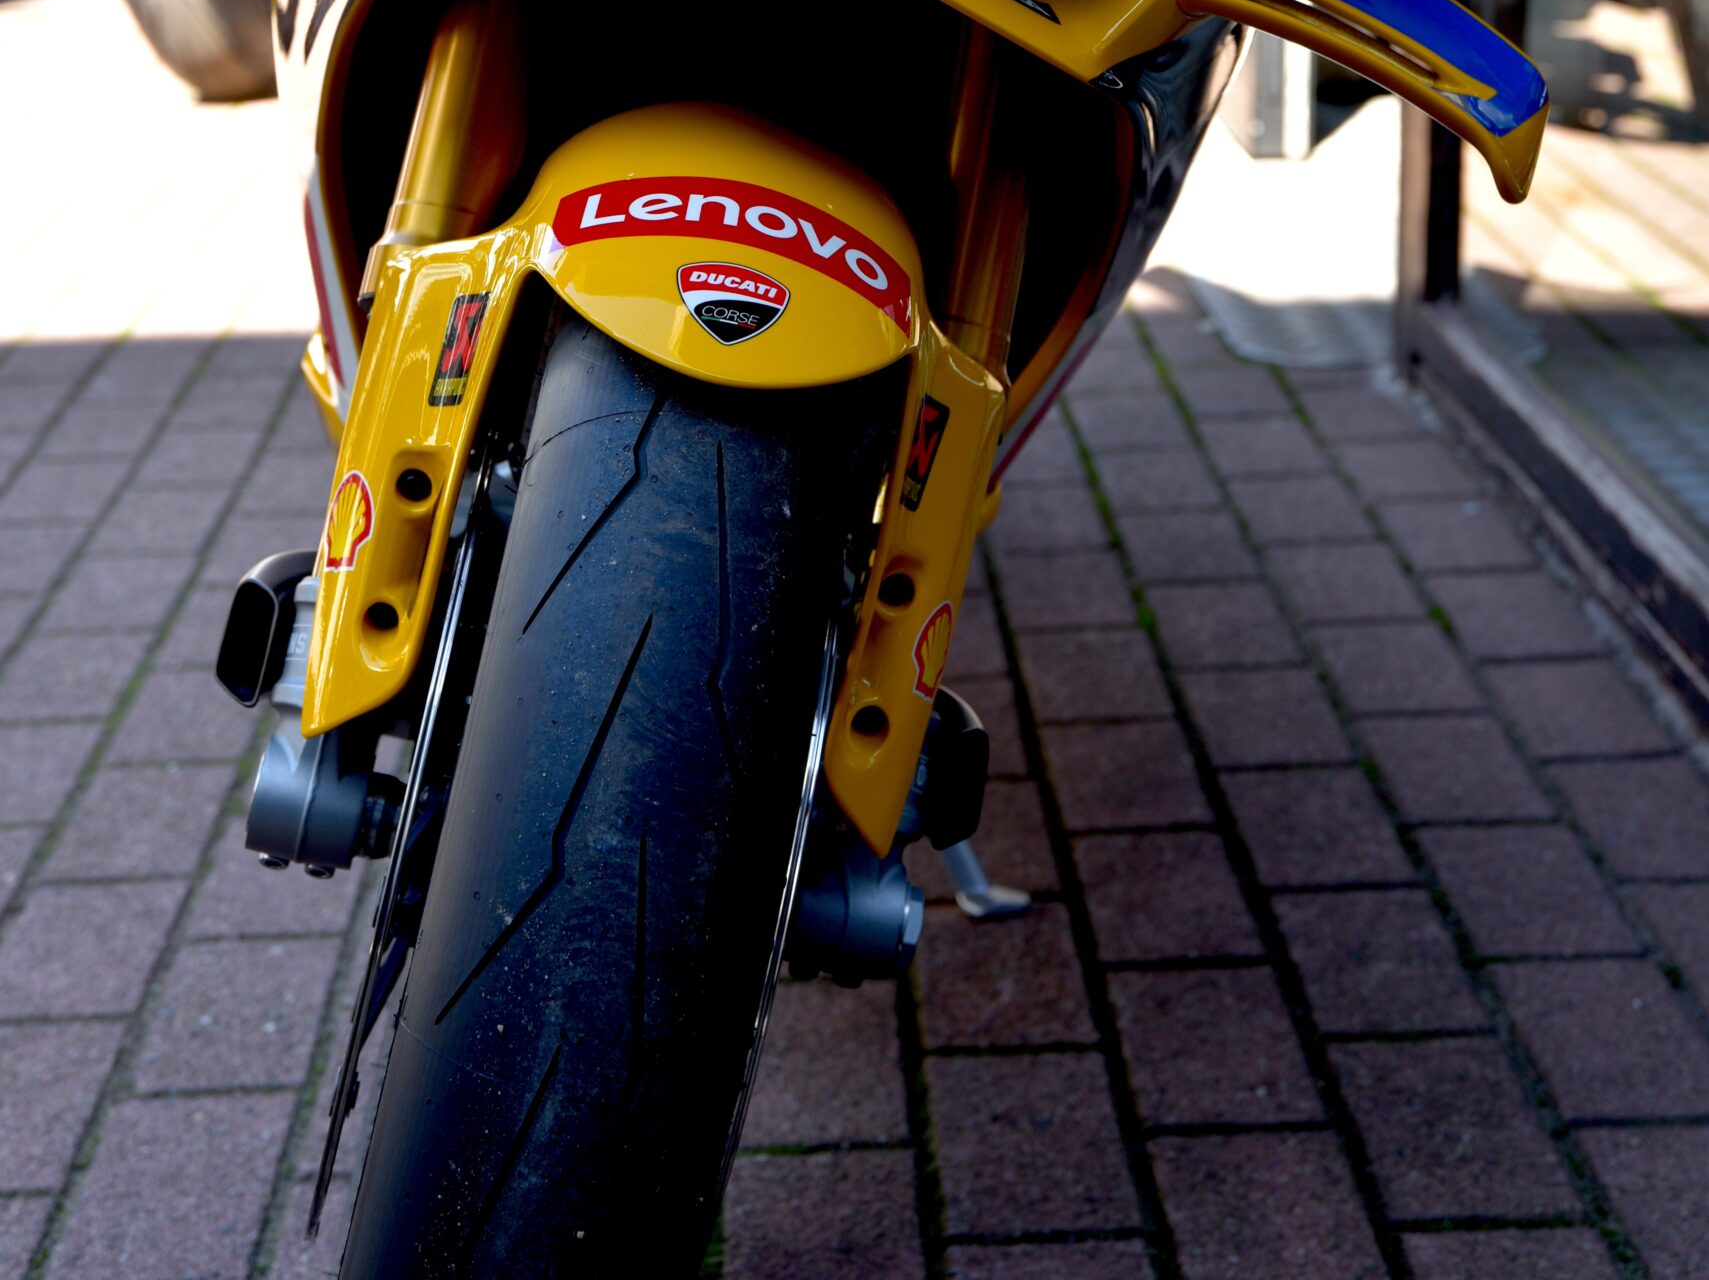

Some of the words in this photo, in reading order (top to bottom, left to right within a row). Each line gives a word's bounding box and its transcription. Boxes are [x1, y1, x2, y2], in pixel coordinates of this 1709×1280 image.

[579, 192, 889, 291] Lenovo
[689, 270, 778, 299] DUCATI
[701, 305, 760, 327] CORSE
